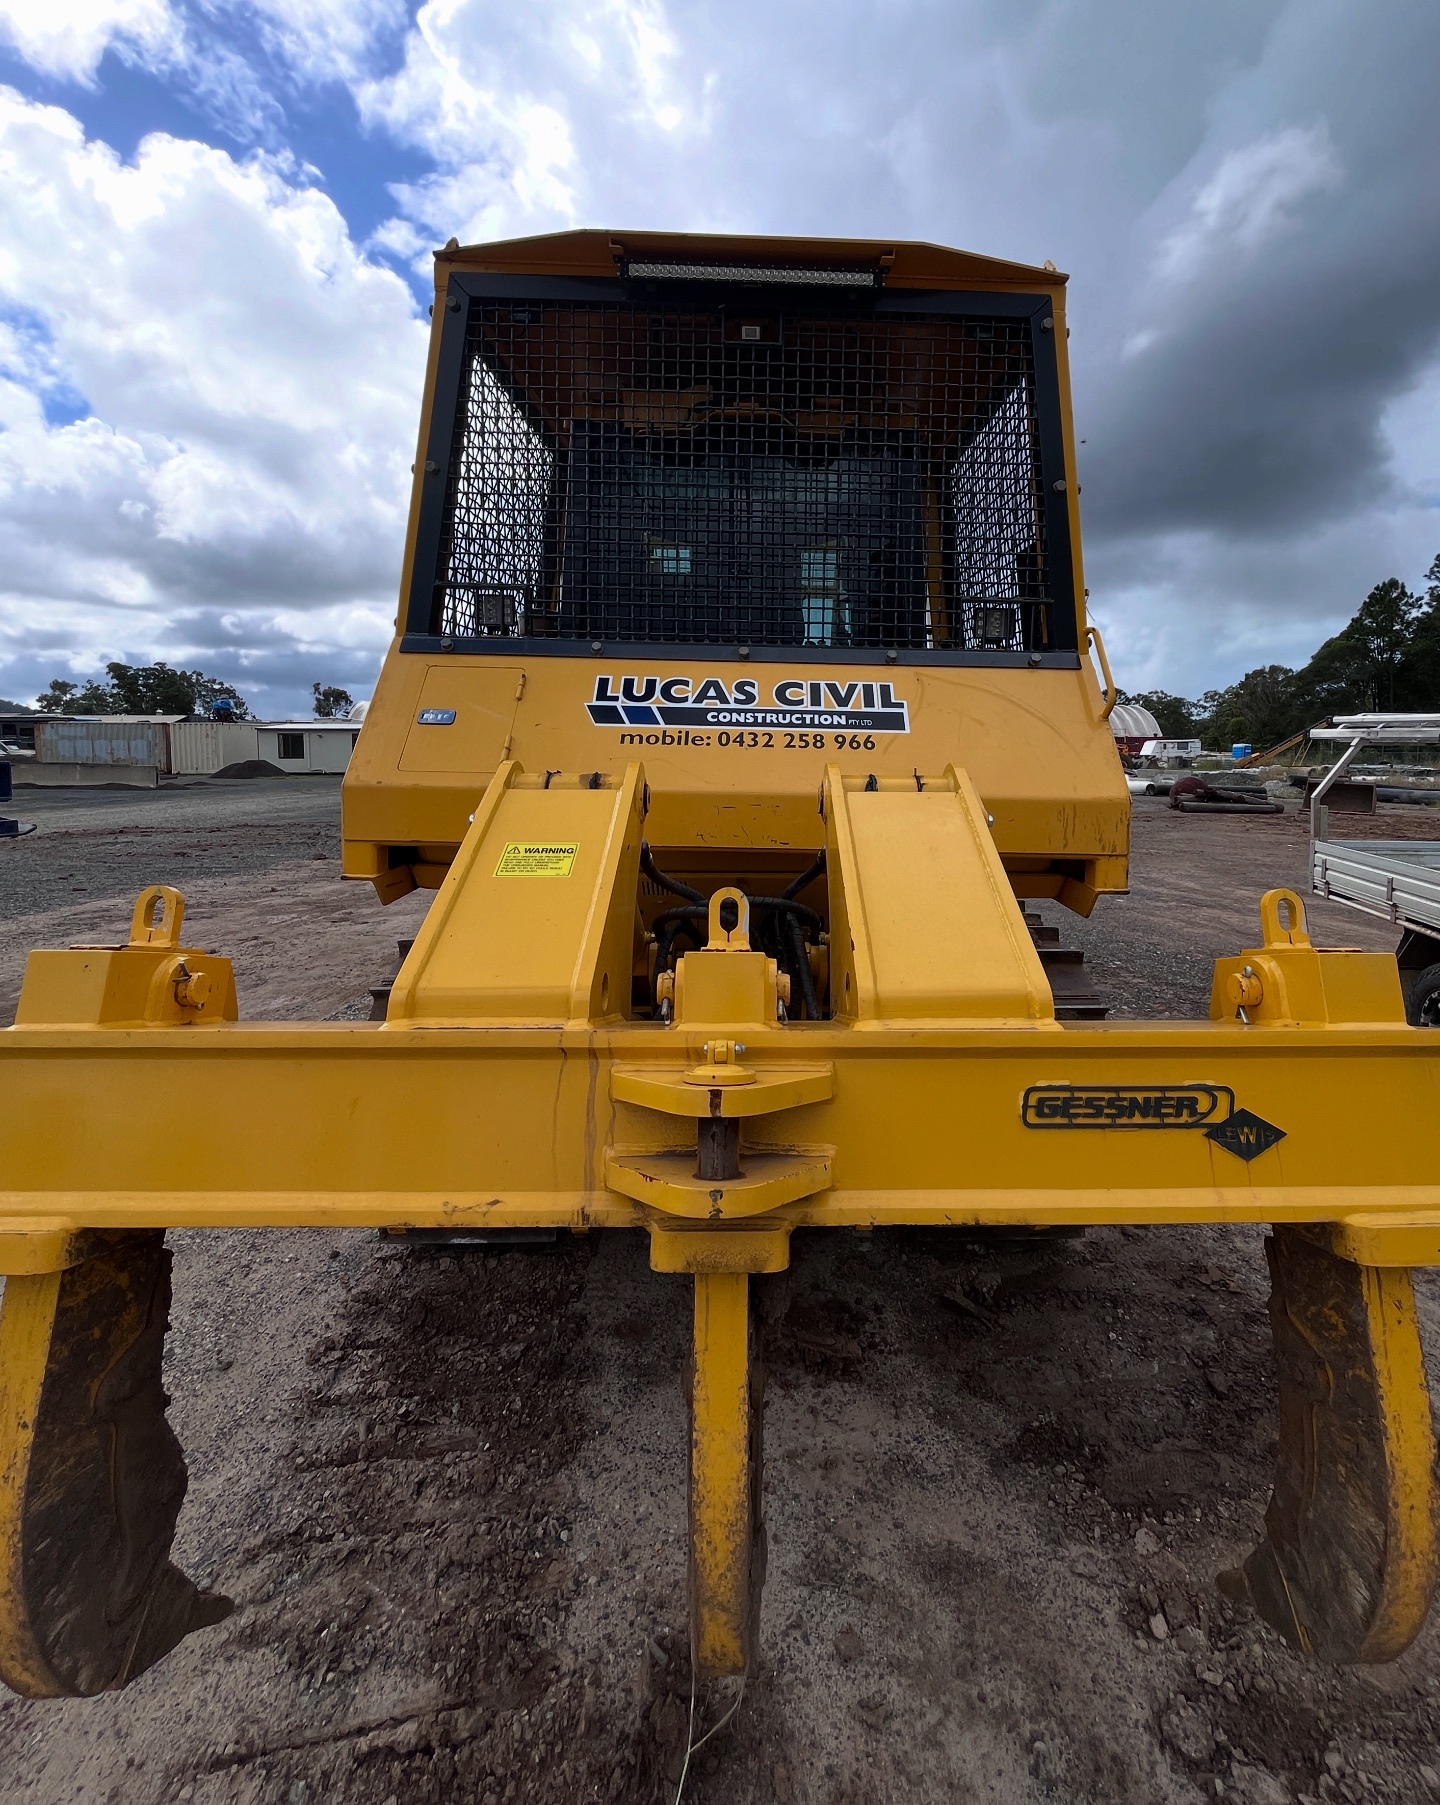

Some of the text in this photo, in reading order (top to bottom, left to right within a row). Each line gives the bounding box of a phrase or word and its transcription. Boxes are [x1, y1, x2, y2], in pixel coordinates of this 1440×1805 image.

[595, 676, 905, 709] LUCAS CIVIL
[706, 711, 847, 726] CONSTRUCTION
[619, 729, 876, 750] mobile: 0432 258 966
[1035, 1096, 1199, 1119] GESSNER
